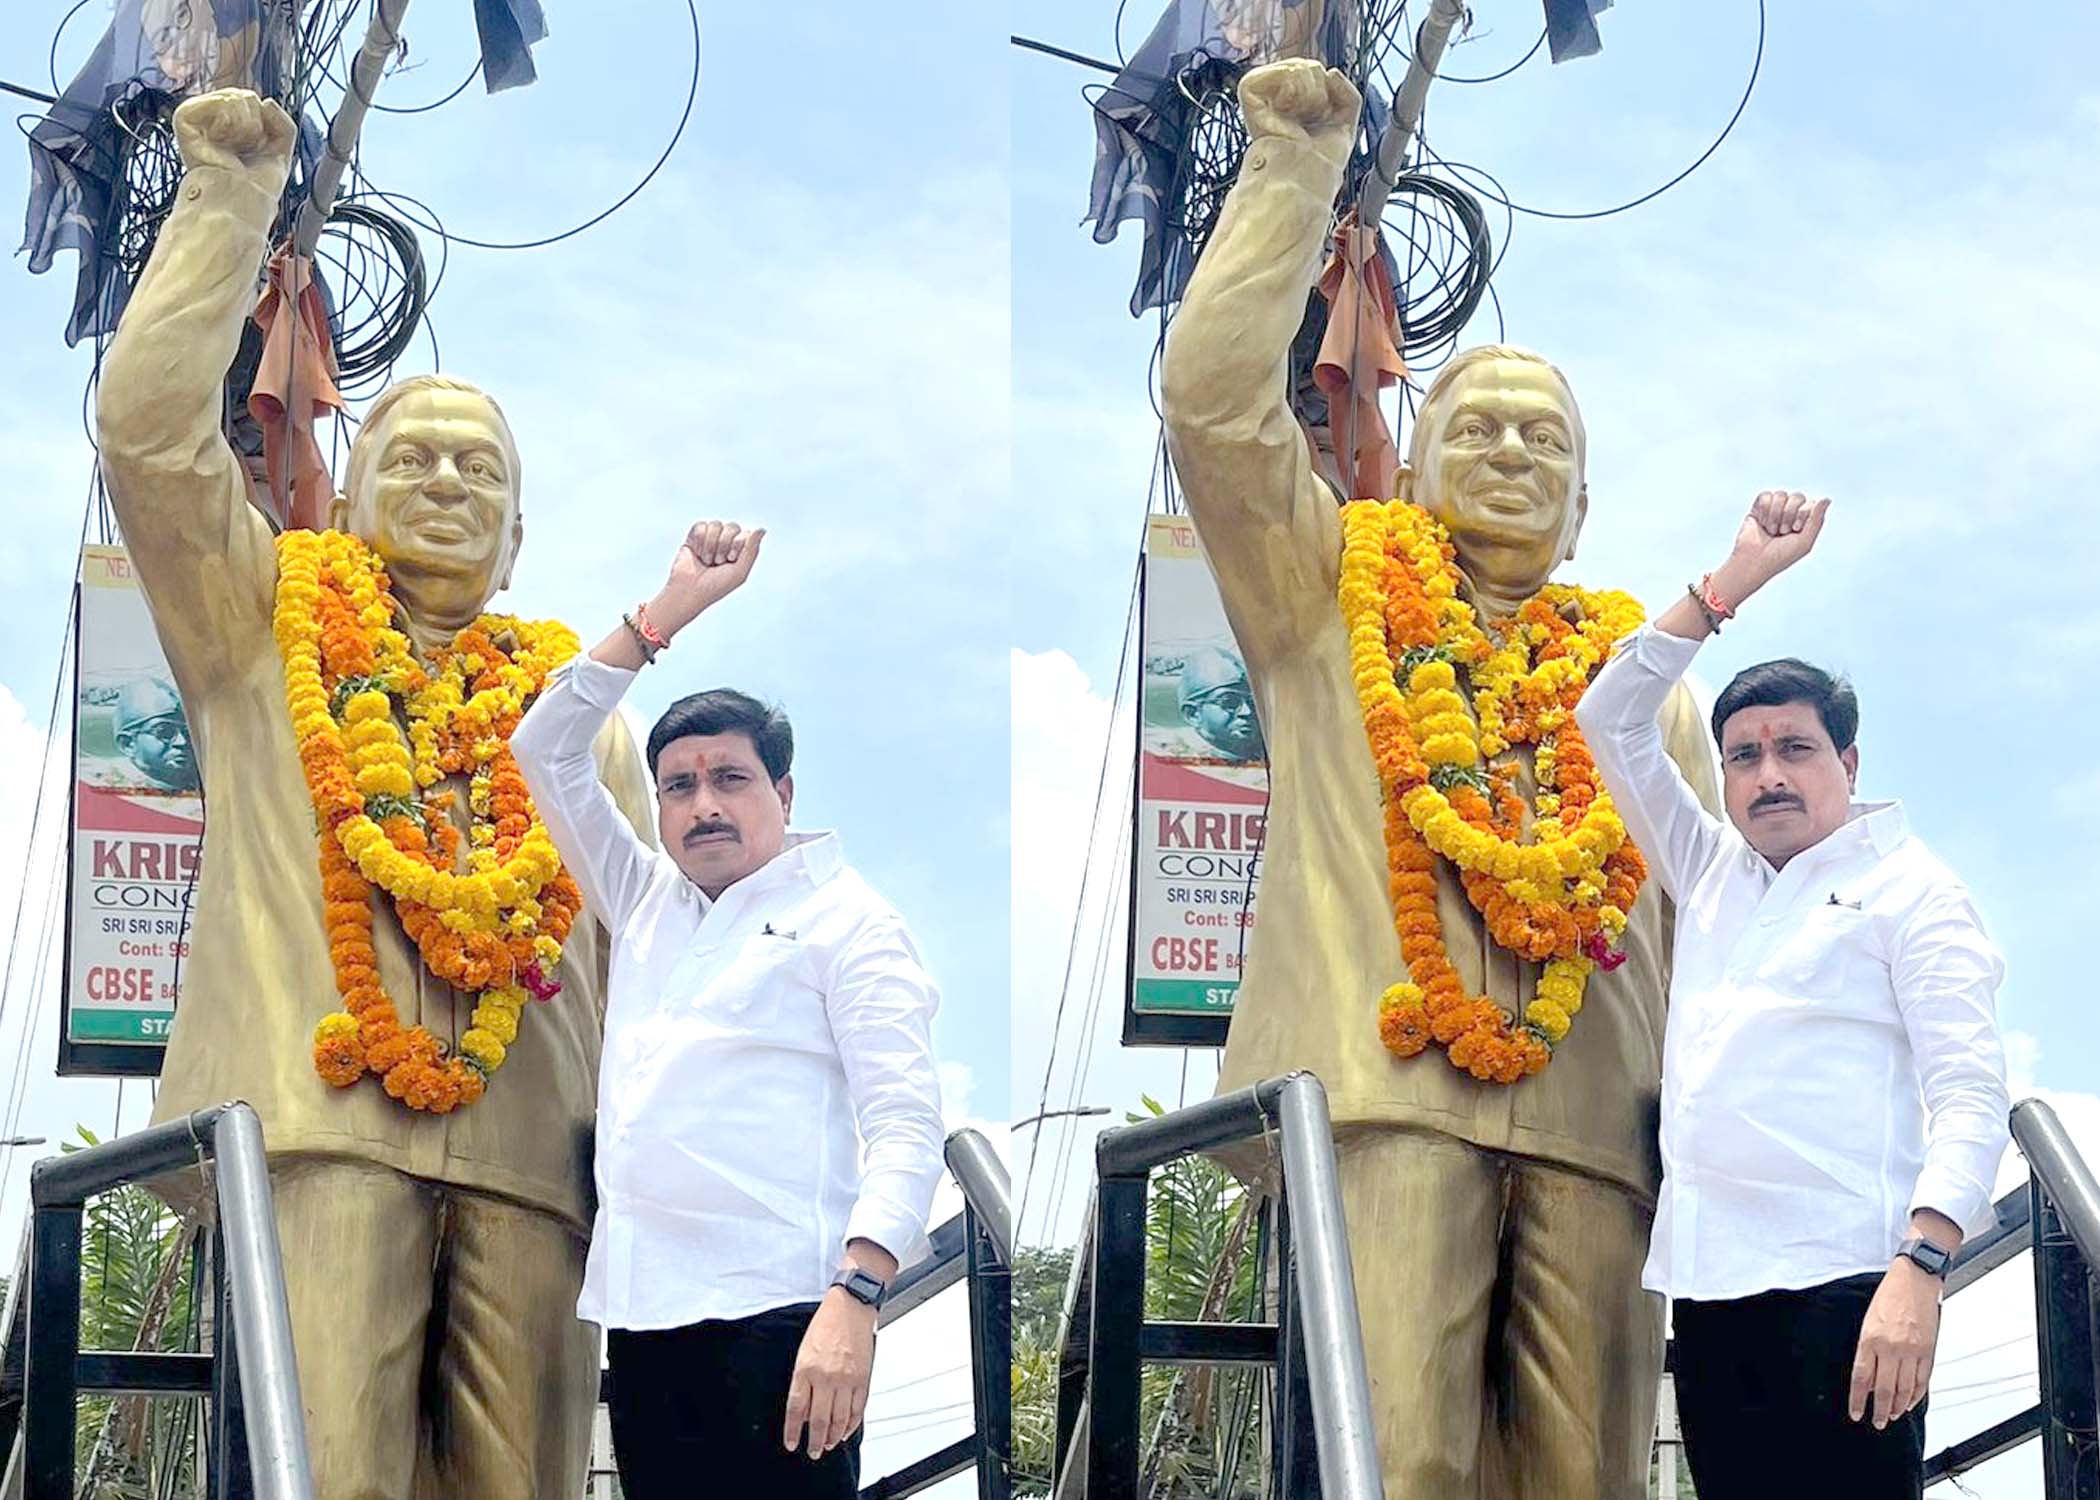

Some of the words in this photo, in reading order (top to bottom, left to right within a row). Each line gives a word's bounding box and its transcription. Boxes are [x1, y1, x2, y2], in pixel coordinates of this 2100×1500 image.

[1158, 810, 1268, 851] KRIS
[93, 840, 203, 881] KRIS
[1167, 887, 1190, 903] SRI
[1194, 889, 1216, 904] SRI
[1220, 890, 1243, 905] SRI
[102, 917, 125, 933] SRI
[129, 919, 151, 934] SRI
[155, 920, 178, 935] SRI
[1184, 910, 1228, 927] Cont:
[119, 940, 163, 957] Cont:
[1151, 936, 1218, 972] CBSE
[86, 966, 153, 1002] CBSE
